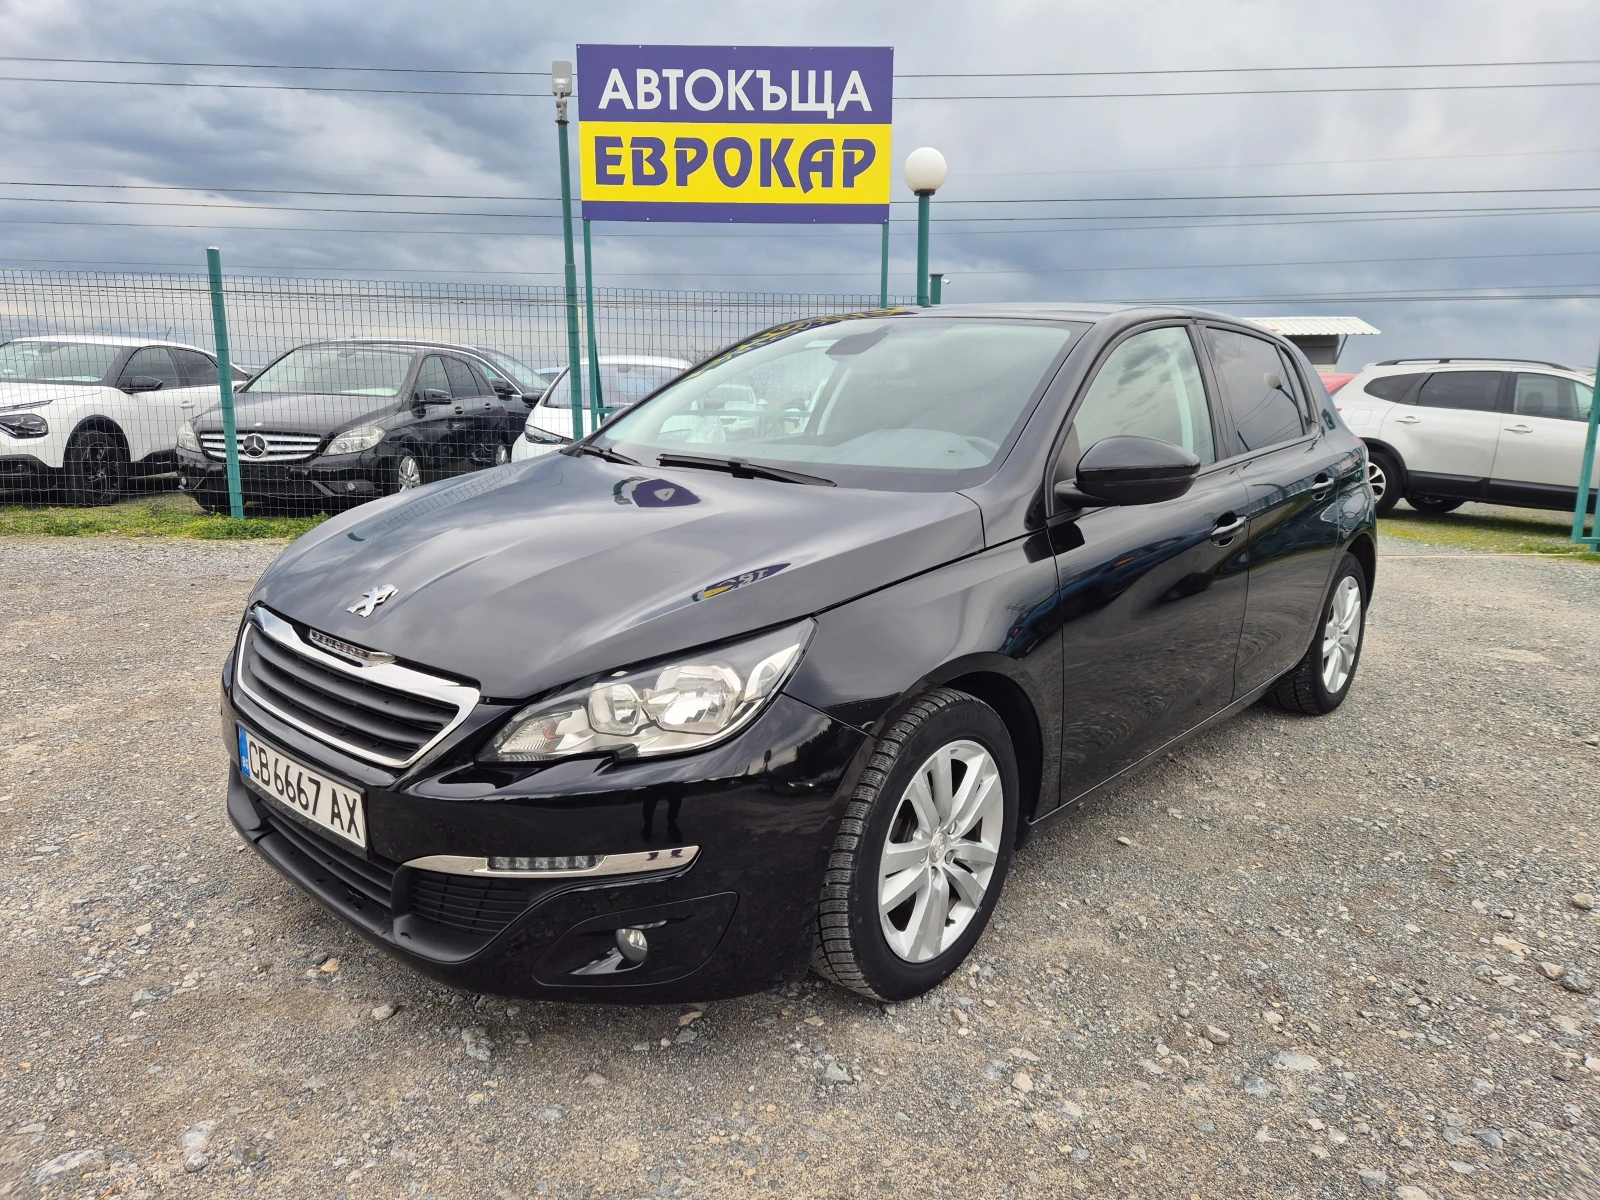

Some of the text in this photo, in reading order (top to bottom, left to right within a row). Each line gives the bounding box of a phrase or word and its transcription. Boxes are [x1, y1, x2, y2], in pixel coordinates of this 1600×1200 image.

[598, 68, 873, 118] АВТОКЪЩА
[594, 135, 876, 193] ЕВРОКАР
[315, 634, 364, 657] PEUGEOT
[330, 788, 361, 840] AX
